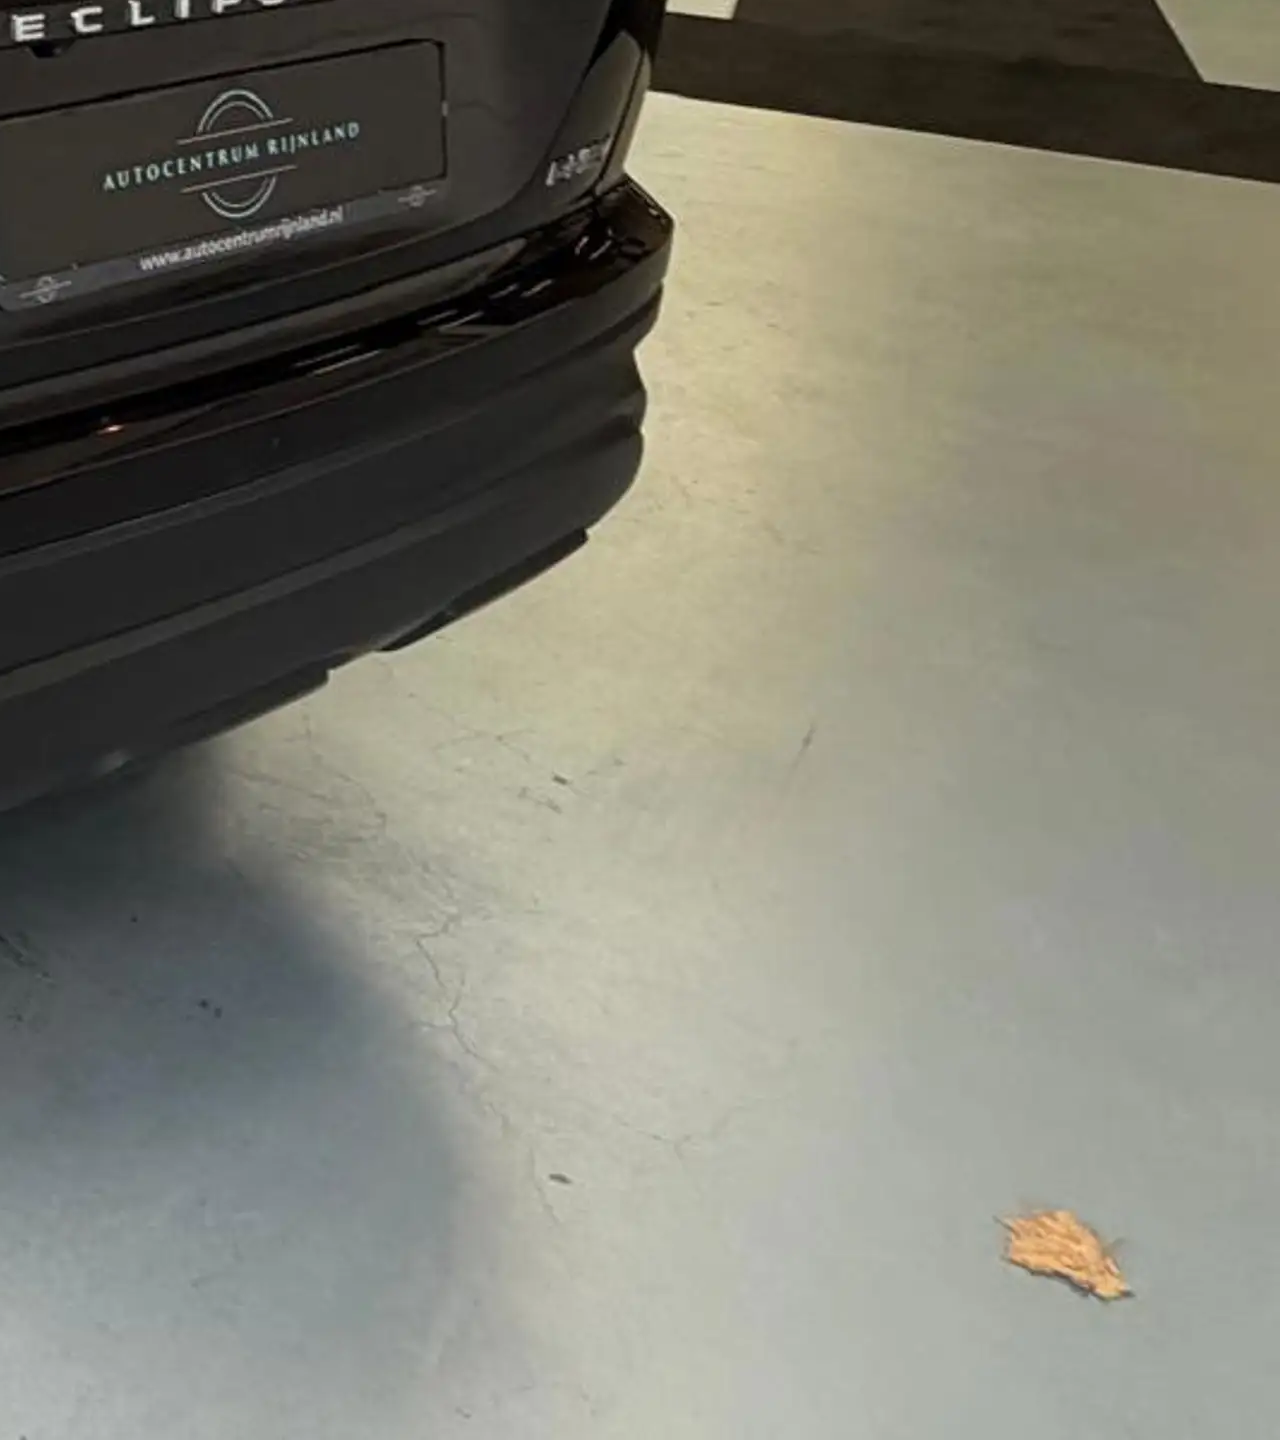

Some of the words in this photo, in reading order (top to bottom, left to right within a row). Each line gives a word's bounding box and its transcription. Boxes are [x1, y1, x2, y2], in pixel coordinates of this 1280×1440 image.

[102, 142, 260, 191] AUTOCENTRUM
[267, 121, 361, 155] RIJNLAND
[140, 205, 344, 271] www.autocentrumrijnland.nl
